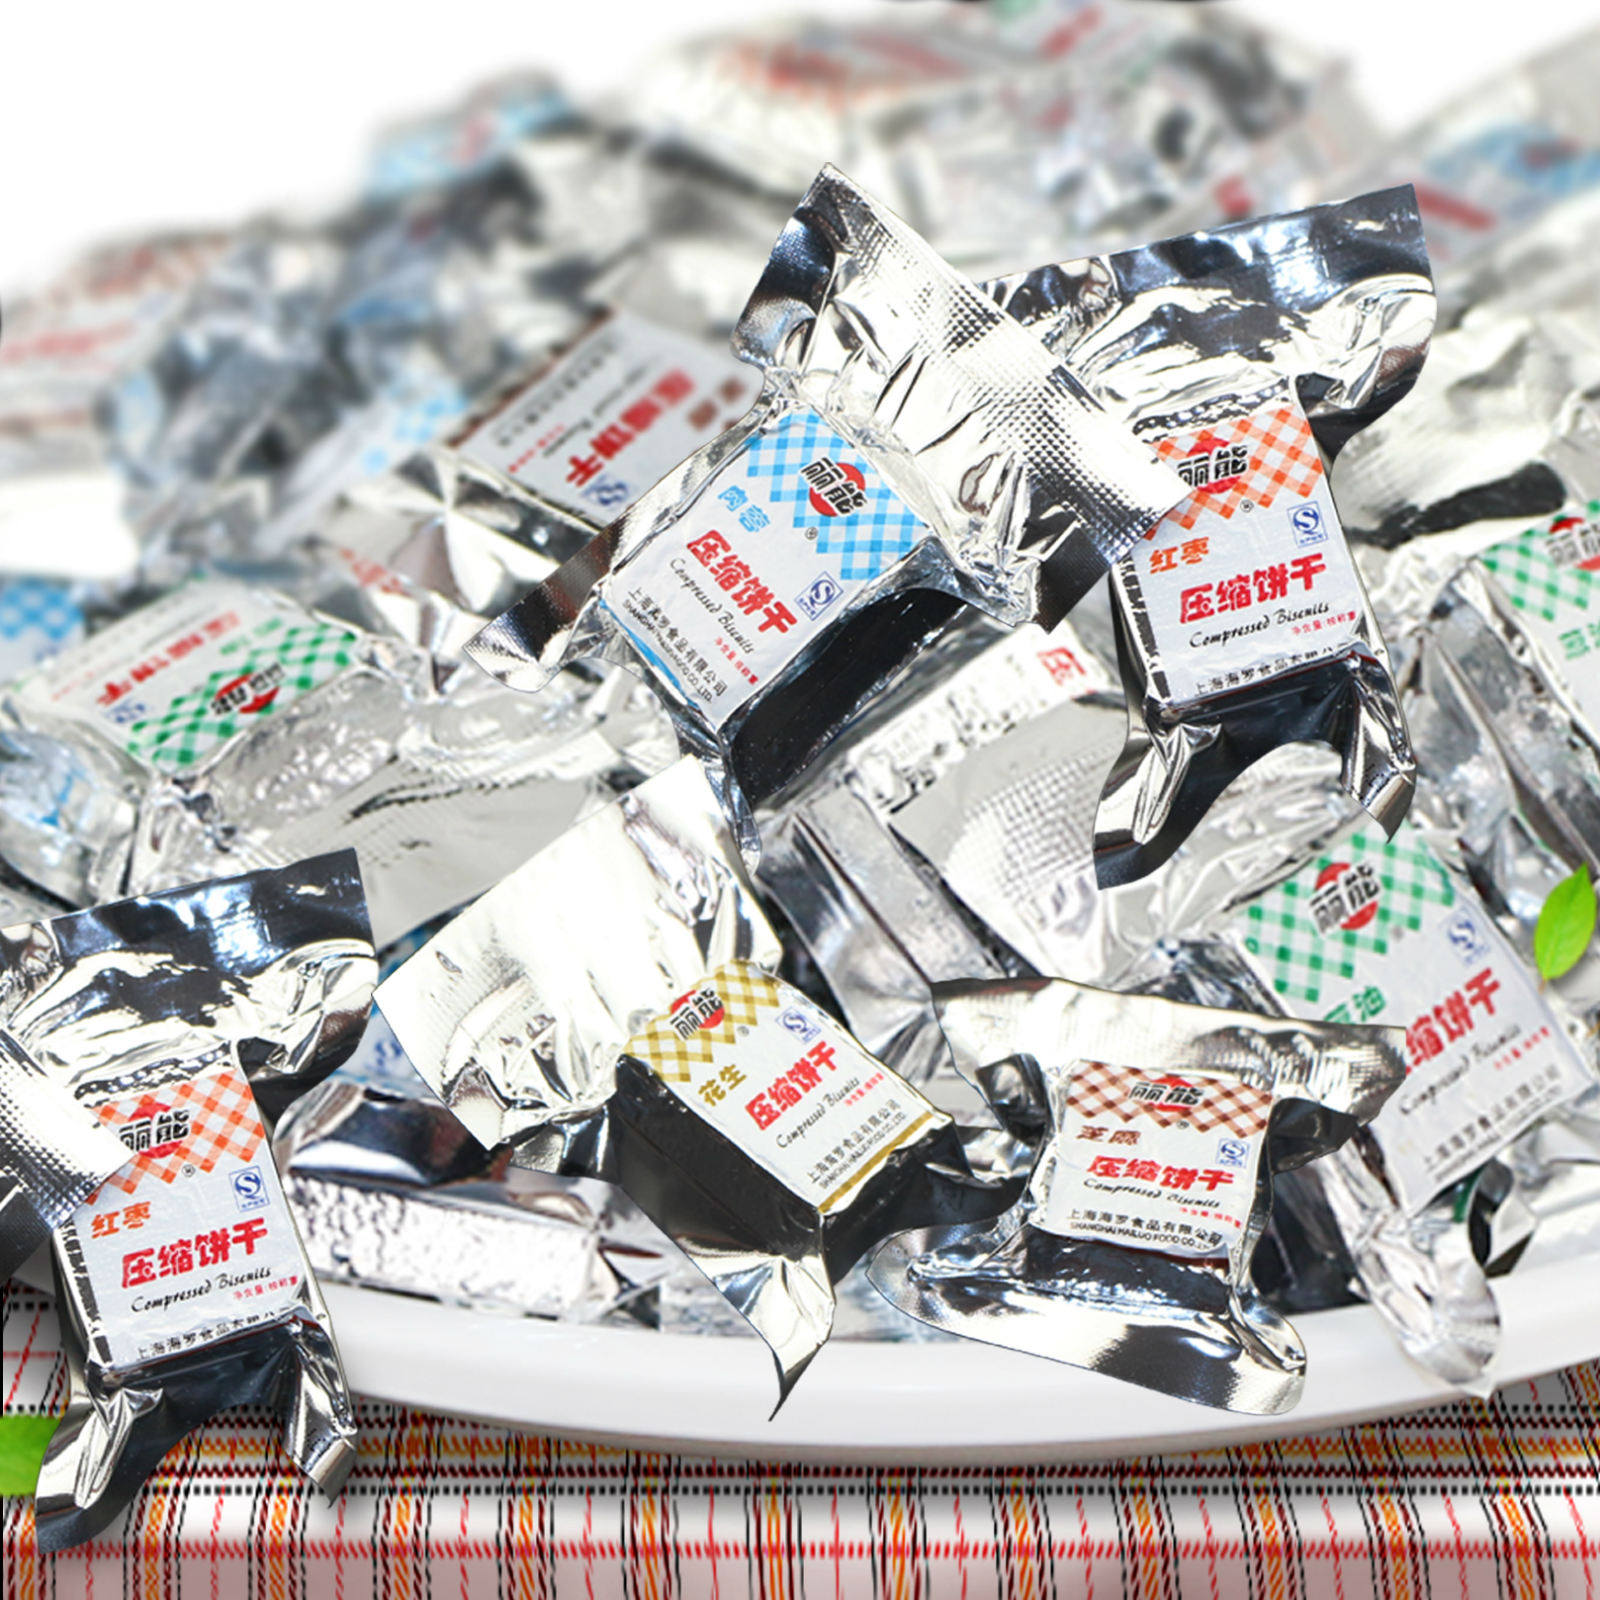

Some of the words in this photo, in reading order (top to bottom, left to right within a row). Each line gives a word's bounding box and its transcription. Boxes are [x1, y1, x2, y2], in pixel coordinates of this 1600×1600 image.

[686, 530, 798, 635] 压缩饼干
[1149, 536, 1209, 574] 红枣
[669, 558, 725, 615] Compressed
[717, 613, 755, 655] Biscuits
[1179, 553, 1326, 624] 压缩饼干
[1189, 614, 1270, 648] Compressed
[1273, 601, 1330, 626] Biscuits
[1406, 967, 1502, 1076] 缩饼干
[698, 1063, 746, 1107] 花生
[745, 1041, 838, 1130] 压缩饼干
[775, 1106, 825, 1150] Compressed
[822, 1076, 860, 1112] Biscuits
[1083, 1179, 1162, 1199] Compressed
[1087, 1155, 1234, 1191] 压缩饼干
[91, 1202, 150, 1239] 红枣
[121, 1218, 268, 1288] 压缩饼干
[131, 1279, 212, 1312] Compressed
[216, 1266, 271, 1290] Biscuits
